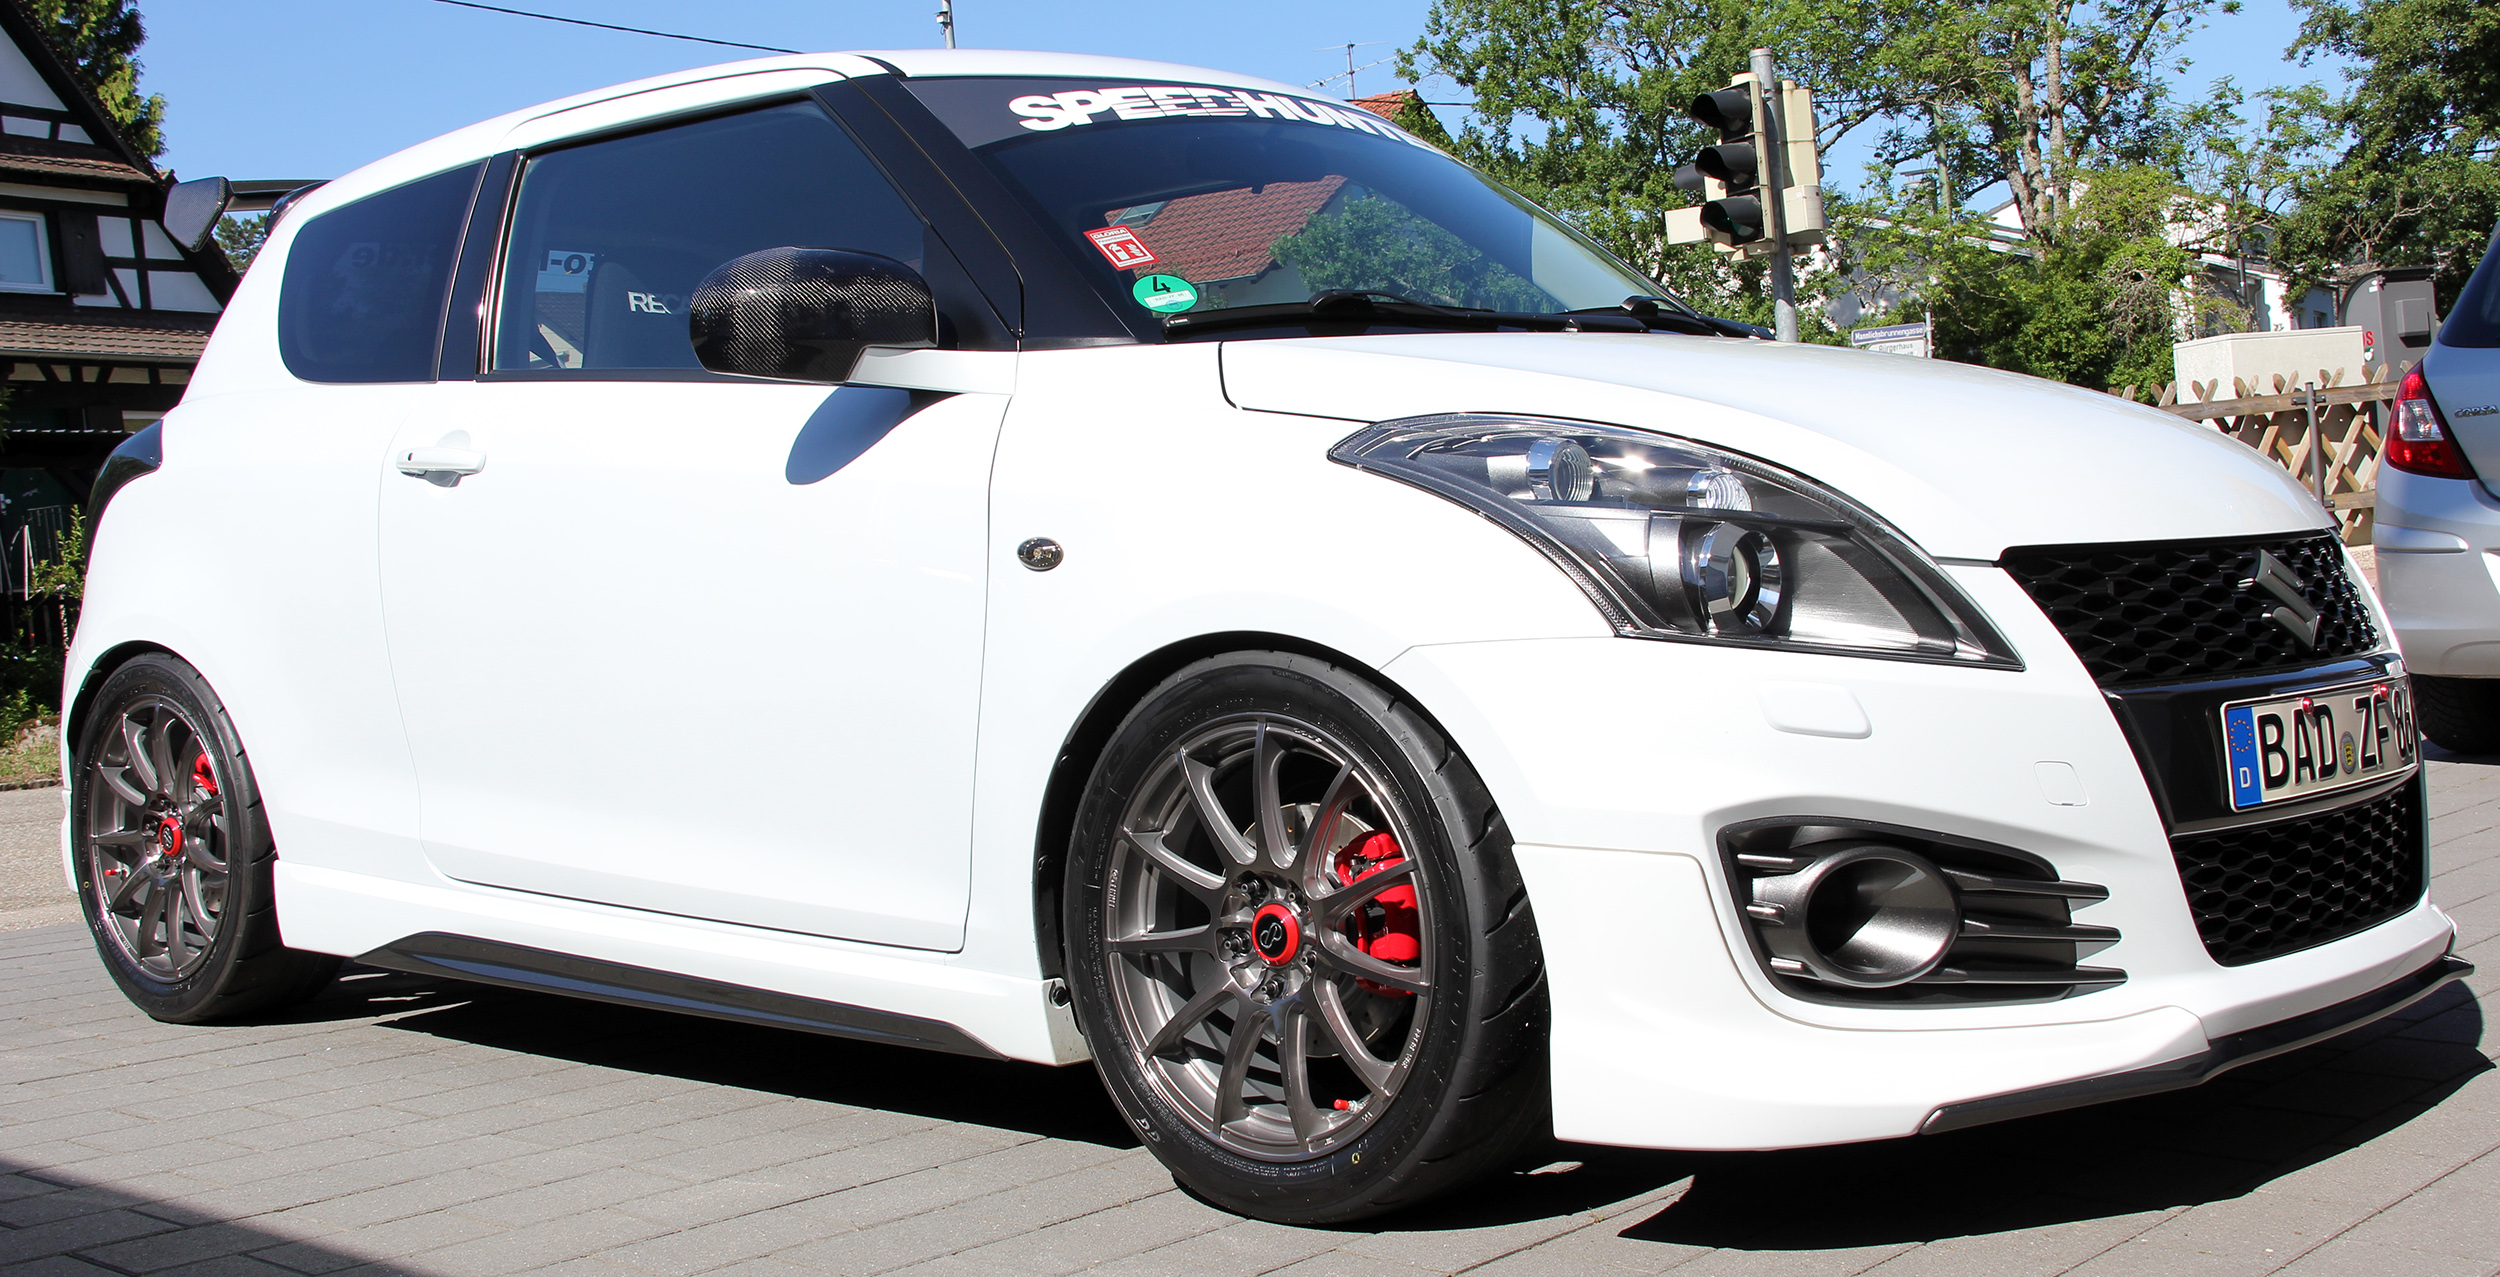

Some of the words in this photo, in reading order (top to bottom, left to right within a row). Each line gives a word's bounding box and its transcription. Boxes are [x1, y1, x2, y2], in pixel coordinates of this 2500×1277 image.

[1008, 86, 1447, 158] SPEEDHUNTE
[1093, 229, 1127, 239] GLORIA
[1152, 276, 1171, 292] 4
[627, 290, 690, 315] RECA
[2454, 405, 2499, 418] CORSA
[2257, 703, 2338, 791] BAD
[2353, 694, 2390, 773] ZF
[2392, 685, 2415, 761] 86
[2239, 767, 2251, 789] D
